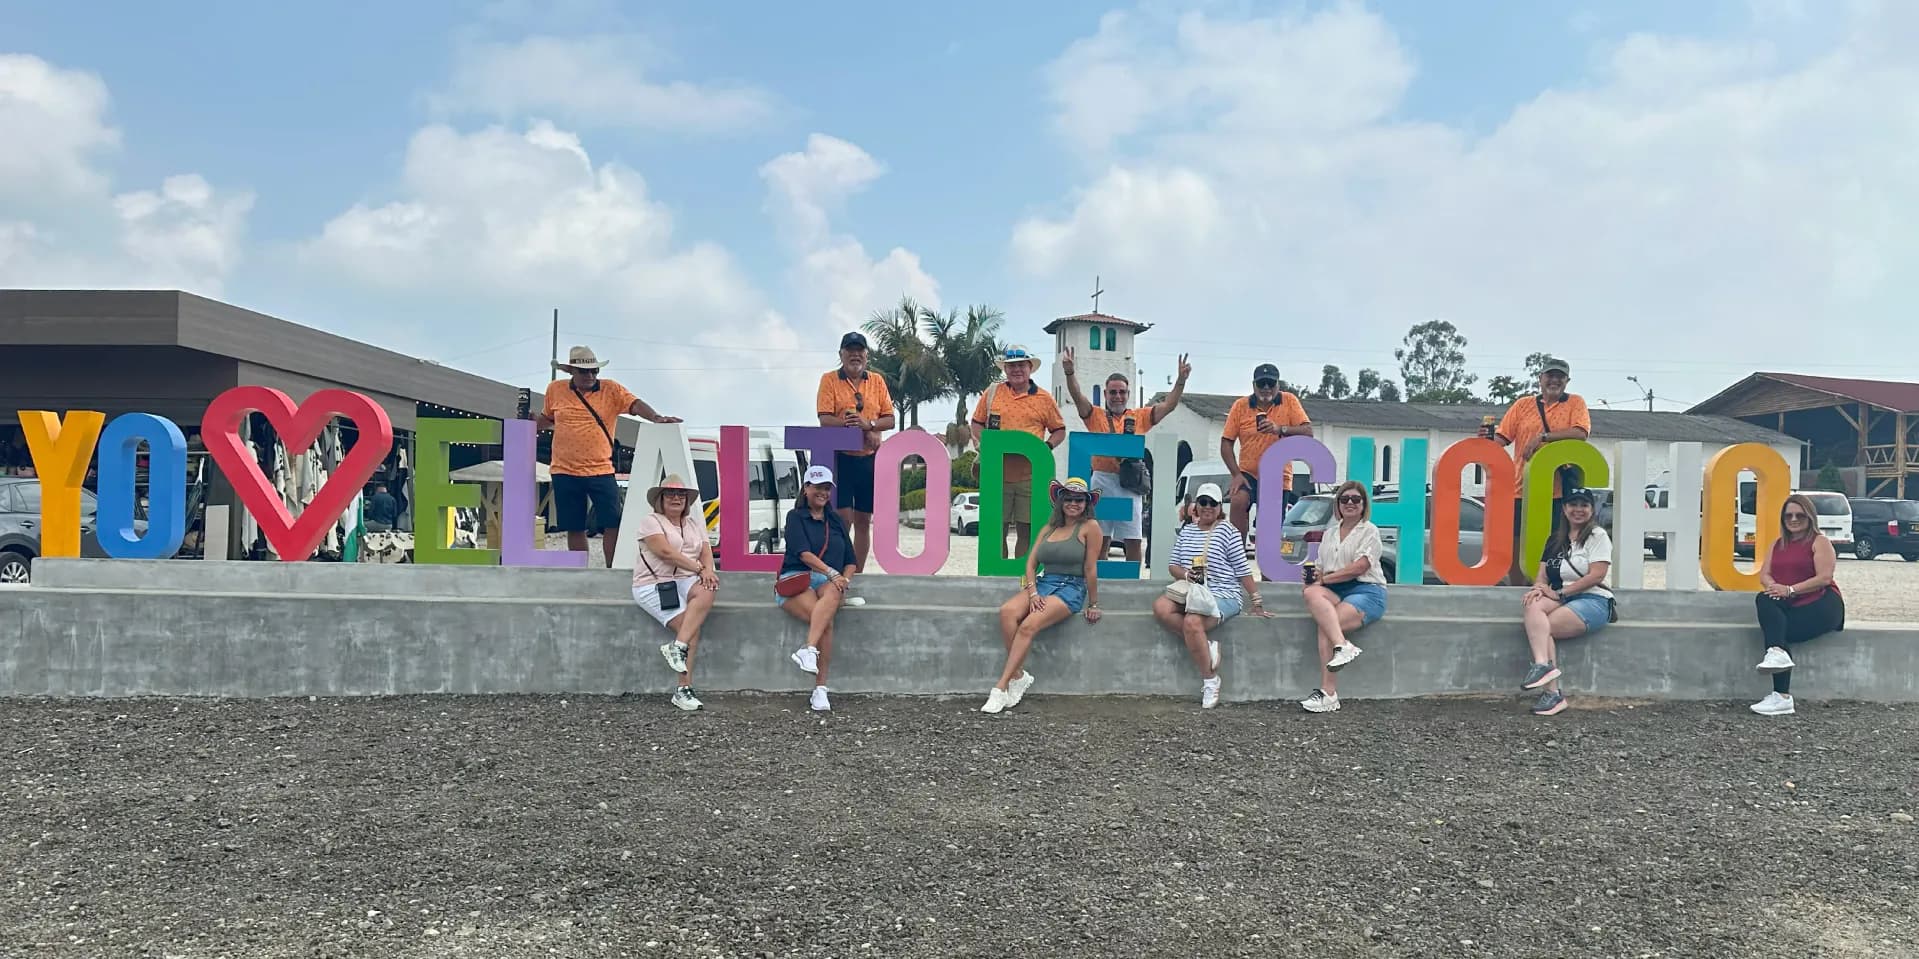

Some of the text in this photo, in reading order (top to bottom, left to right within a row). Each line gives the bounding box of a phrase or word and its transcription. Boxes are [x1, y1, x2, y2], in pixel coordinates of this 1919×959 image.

[18, 410, 187, 559] YO
[415, 417, 588, 567] EL
[612, 421, 950, 576] ALTO
[1256, 434, 1790, 592] CHOCHO
